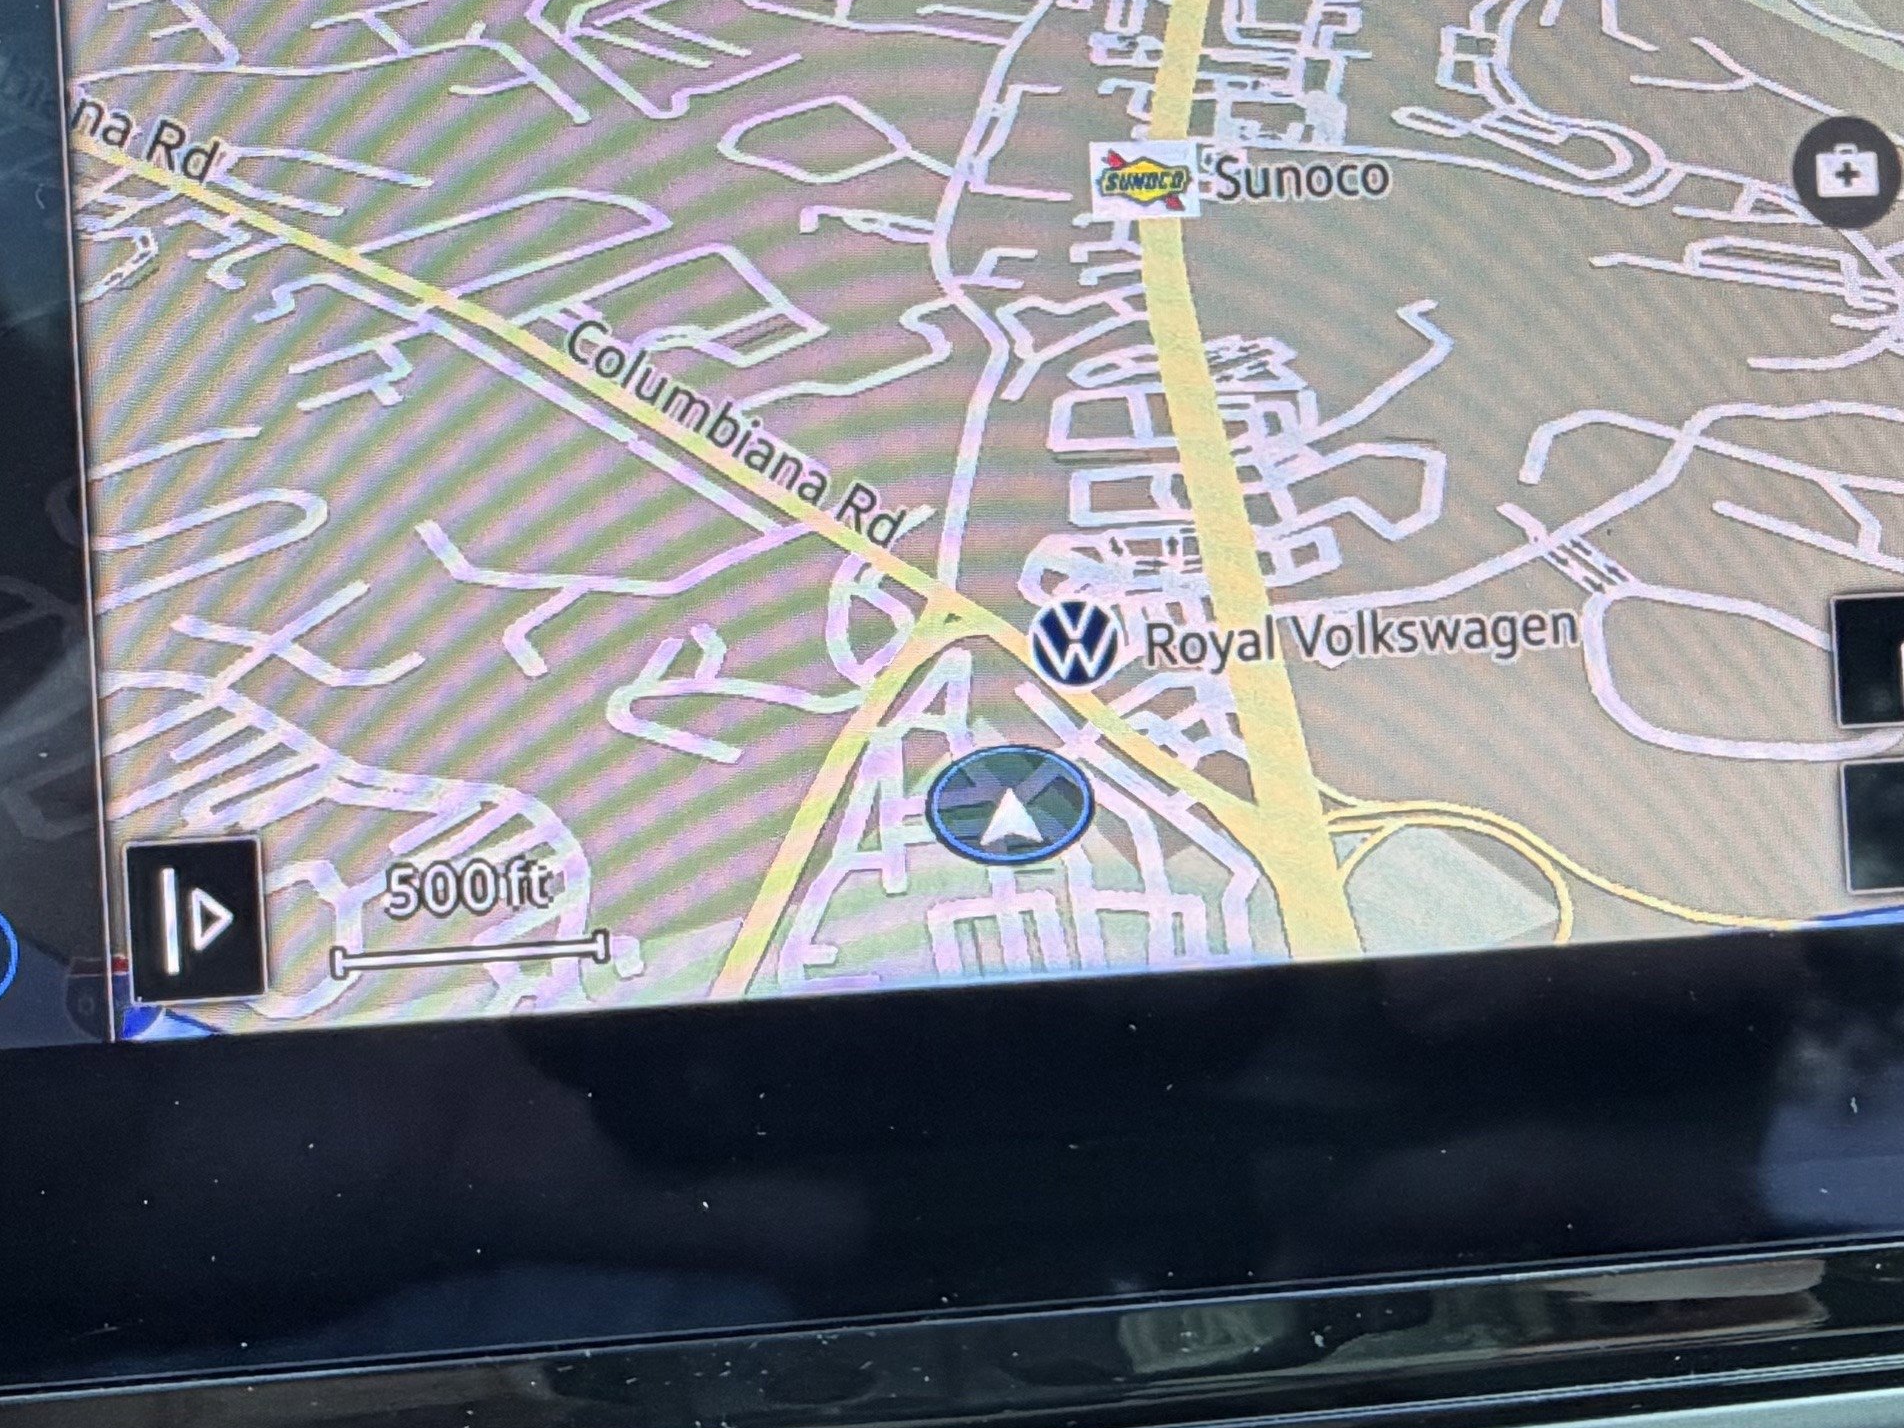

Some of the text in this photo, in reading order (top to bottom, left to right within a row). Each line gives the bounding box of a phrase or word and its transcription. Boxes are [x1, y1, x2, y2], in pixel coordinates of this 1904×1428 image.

[146, 118, 221, 183] Rd
[1214, 154, 1391, 201] Sunoco
[566, 318, 908, 548] Columbiana Rd
[1145, 608, 1580, 675] Royal Volkswagen
